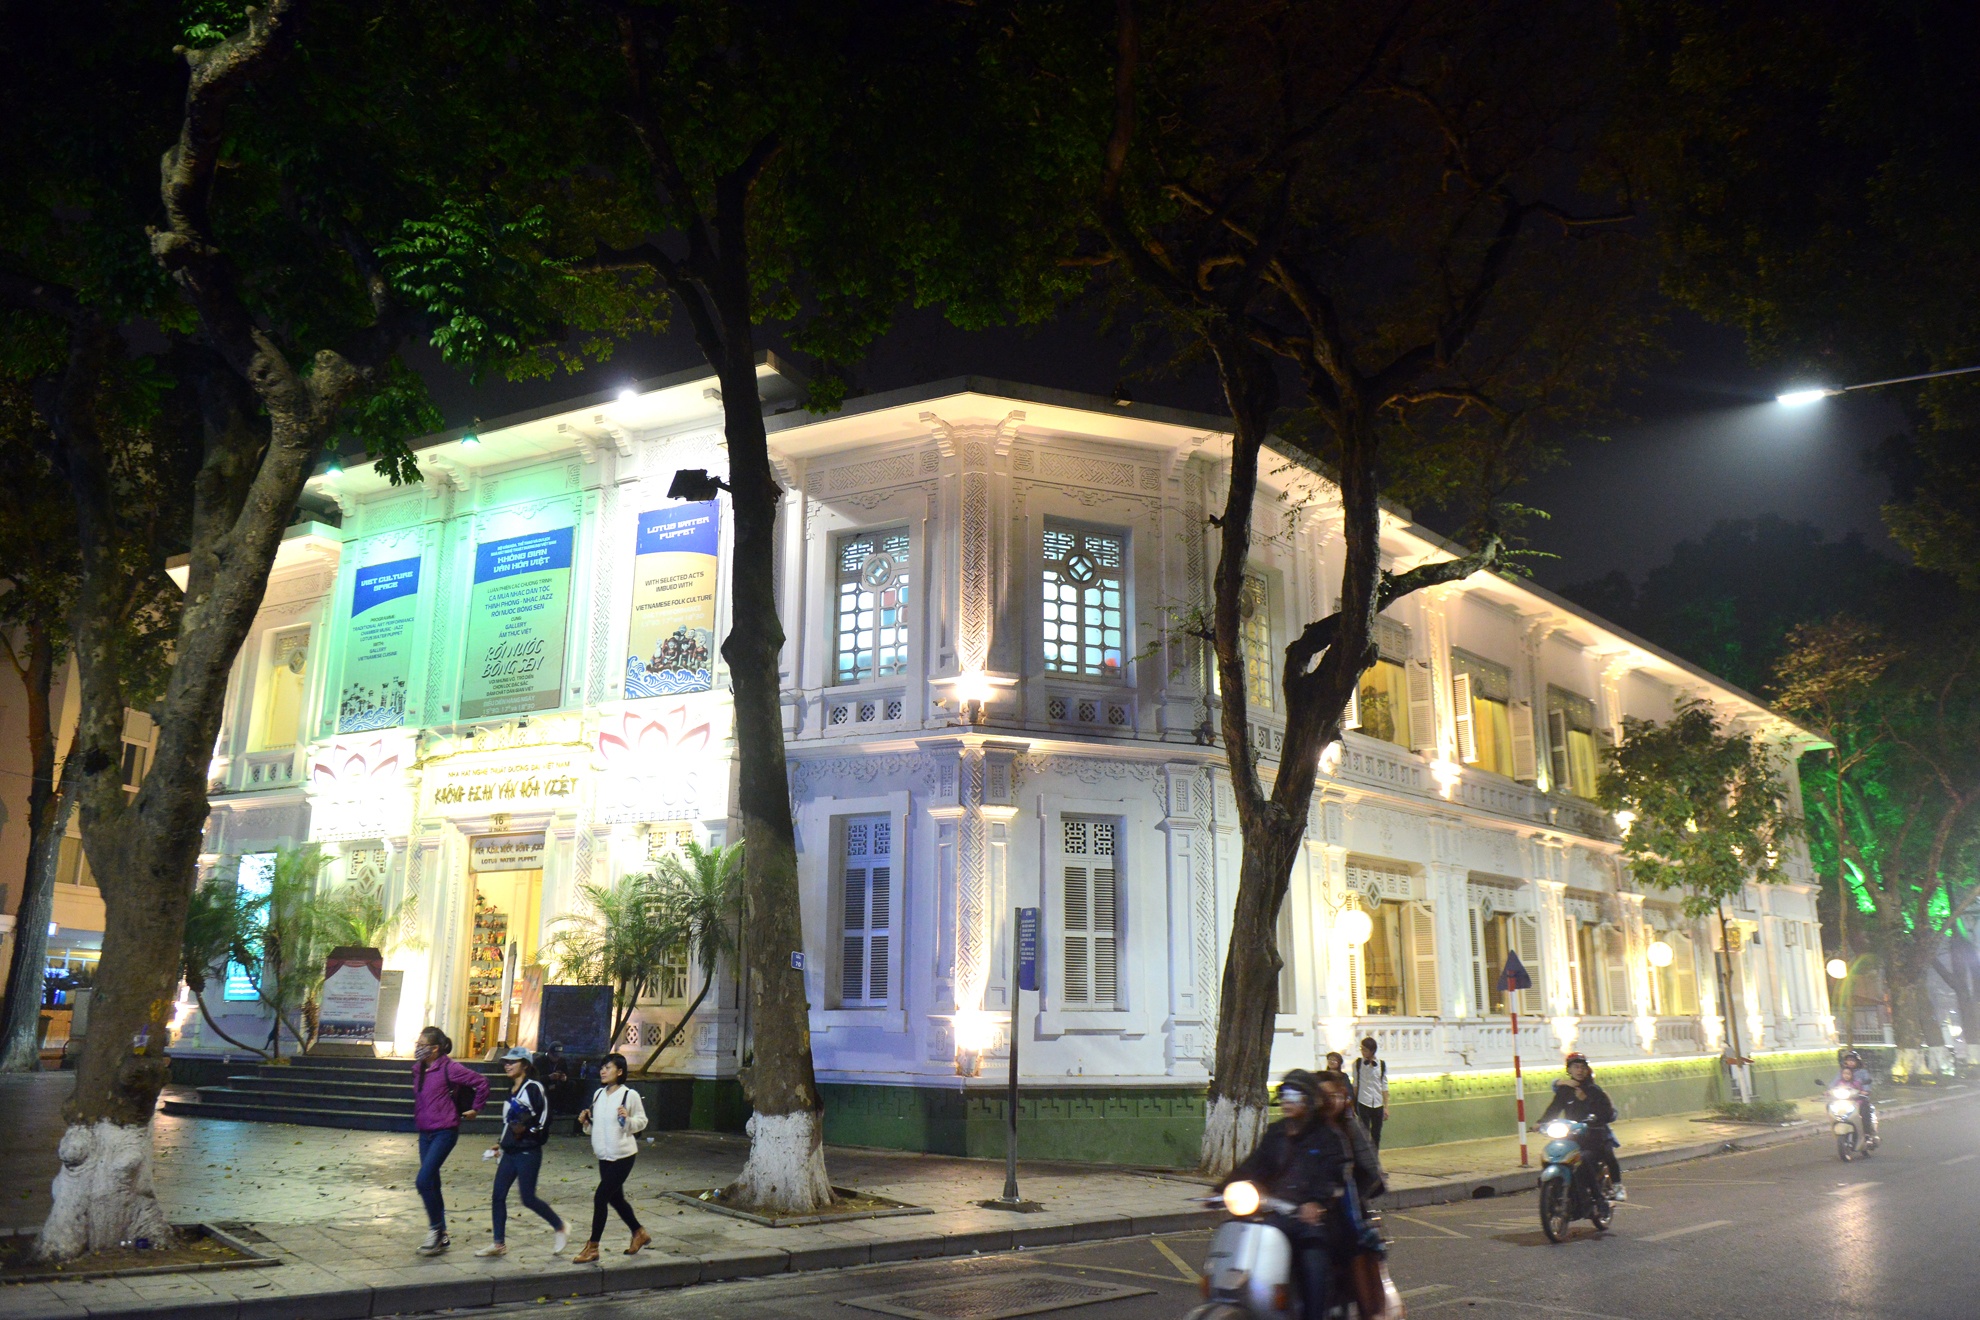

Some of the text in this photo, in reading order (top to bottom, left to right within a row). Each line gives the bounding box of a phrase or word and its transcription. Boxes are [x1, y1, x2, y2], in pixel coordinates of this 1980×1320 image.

[647, 516, 710, 534] LOTUS WATER
[660, 528, 696, 540] PUPPET
[378, 571, 413, 583] CULTURE
[660, 574, 688, 584] SELECTED
[374, 582, 398, 592] SPACE
[656, 581, 693, 592] IMBUED WITH
[636, 601, 670, 611] VIETNAMESE
[686, 594, 712, 604] CULTURE
[544, 774, 579, 798] VIỆT
[494, 816, 504, 826] 16
